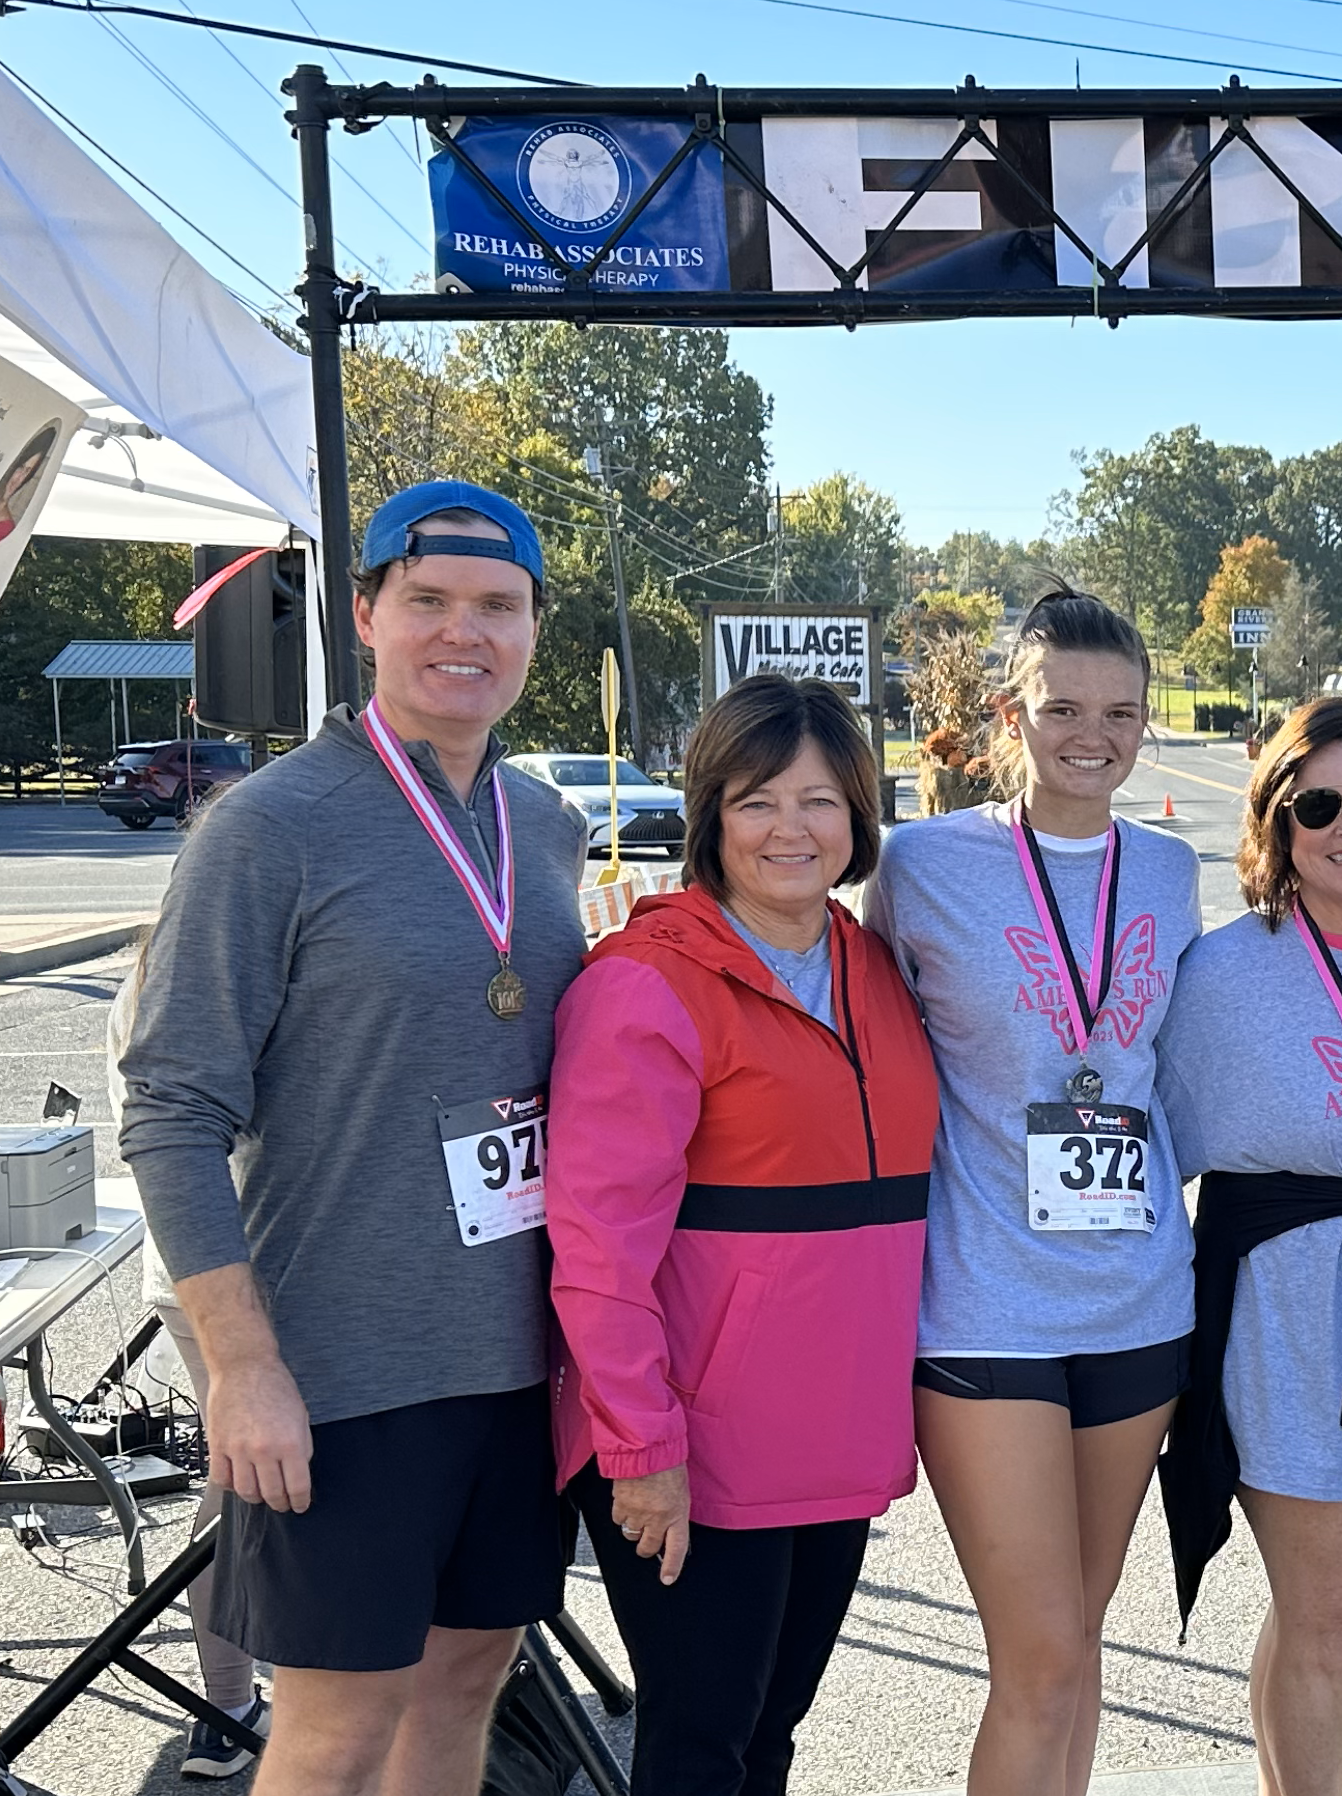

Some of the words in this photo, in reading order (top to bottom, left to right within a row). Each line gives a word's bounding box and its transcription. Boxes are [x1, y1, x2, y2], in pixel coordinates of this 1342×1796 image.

[525, 129, 554, 157] REHAB
[557, 125, 620, 158] ASSOCIATES
[526, 194, 577, 230] PHYSICAL
[582, 196, 625, 229] THERAPY
[453, 232, 544, 260] REHAB
[590, 270, 660, 287] HERAPY
[1238, 632, 1271, 643] INN
[720, 623, 864, 686] VILLAGE
[1133, 969, 1169, 999] RUN
[496, 990, 523, 1010] 10K
[477, 1119, 549, 1190] 97
[1060, 1136, 1145, 1193] 372
